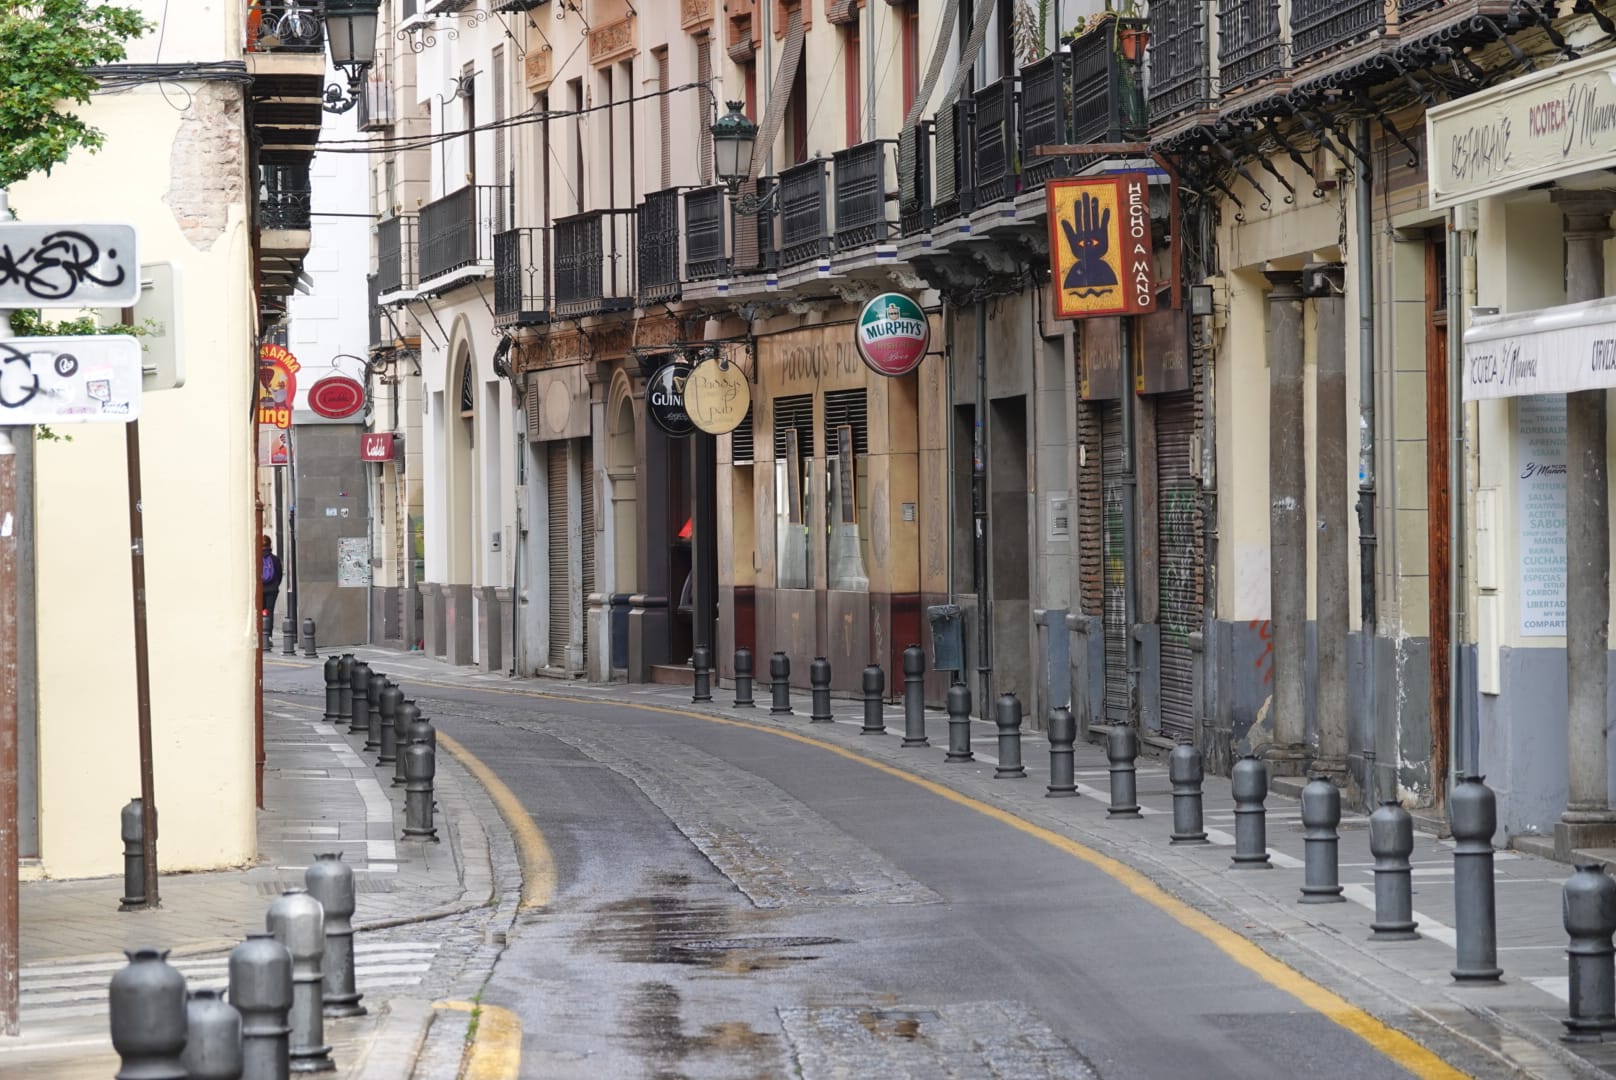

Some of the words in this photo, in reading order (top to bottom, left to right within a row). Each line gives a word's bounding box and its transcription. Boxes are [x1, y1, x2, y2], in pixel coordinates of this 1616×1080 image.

[1529, 100, 1567, 137] PICOTECA
[1128, 182, 1143, 238] HECHO
[1134, 244, 1146, 254] A
[1132, 261, 1150, 306] MANO
[866, 320, 922, 340] MURPHY'S
